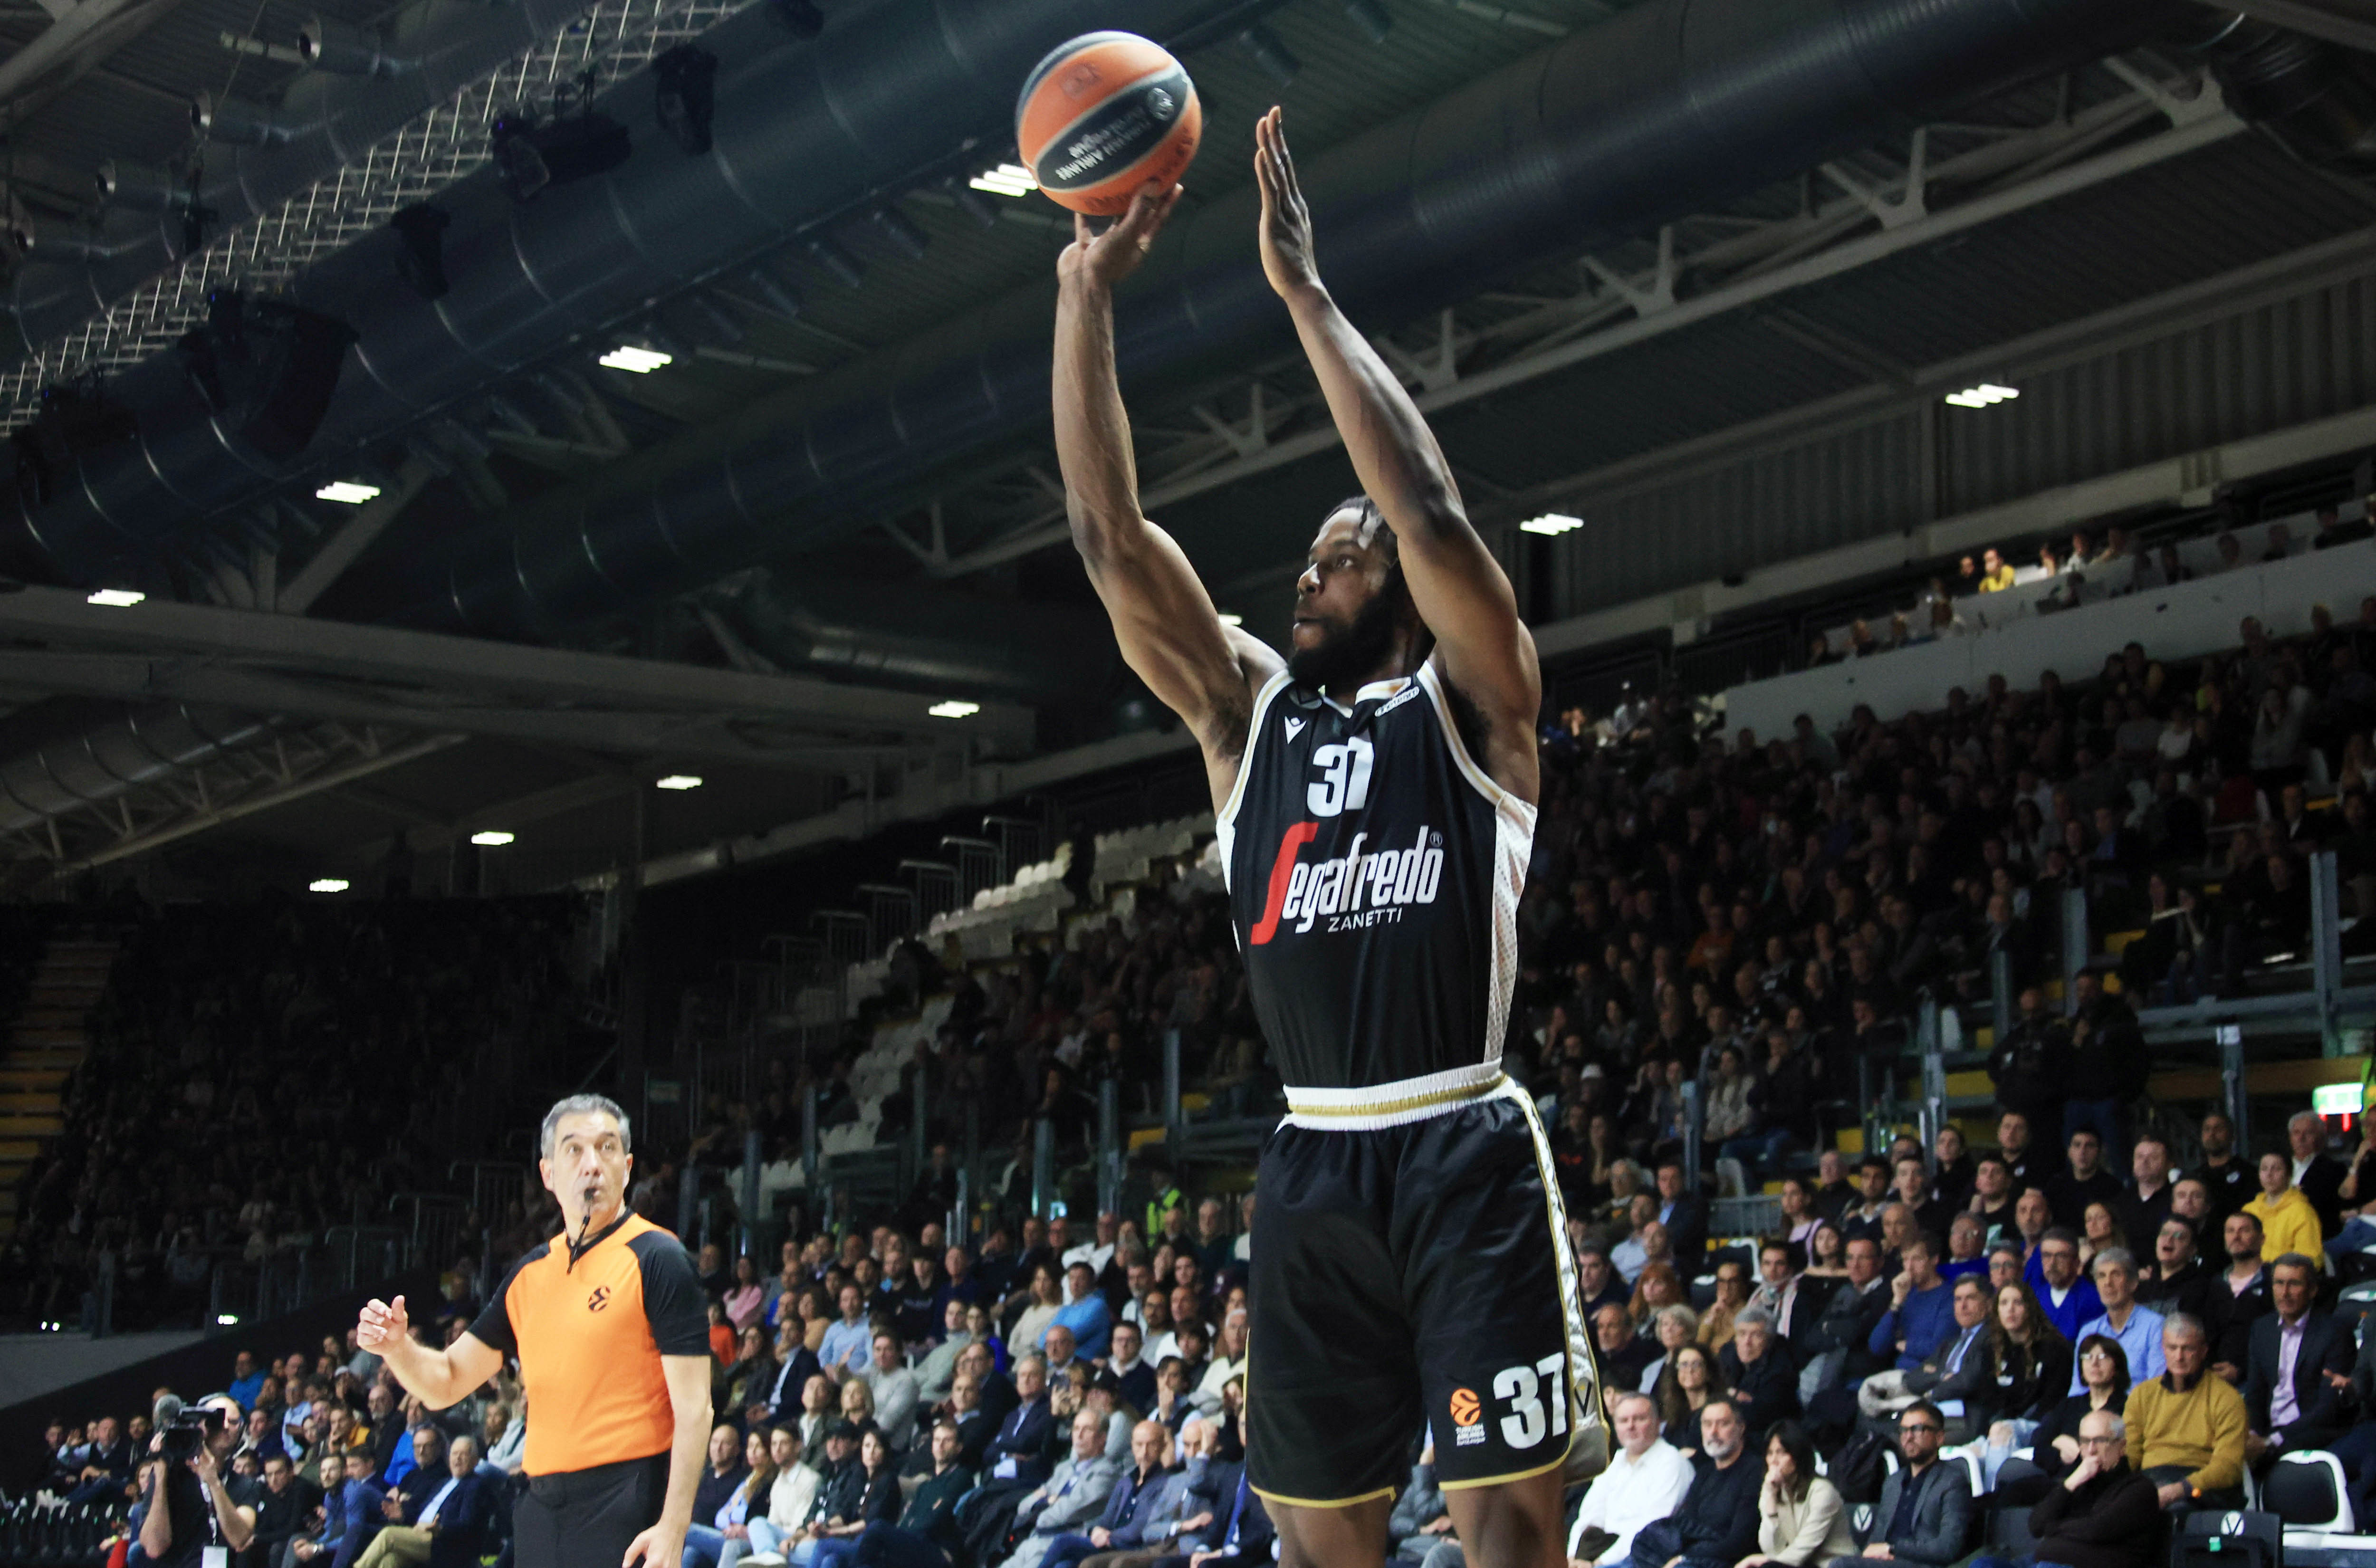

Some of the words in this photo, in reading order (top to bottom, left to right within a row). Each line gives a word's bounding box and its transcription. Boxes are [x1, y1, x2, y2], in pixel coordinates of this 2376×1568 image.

[1306, 736, 1375, 817] 37
[1250, 822, 1444, 945] Segafredo
[1328, 907, 1402, 932] ZANETTI
[1493, 1351, 1567, 1449] 37
